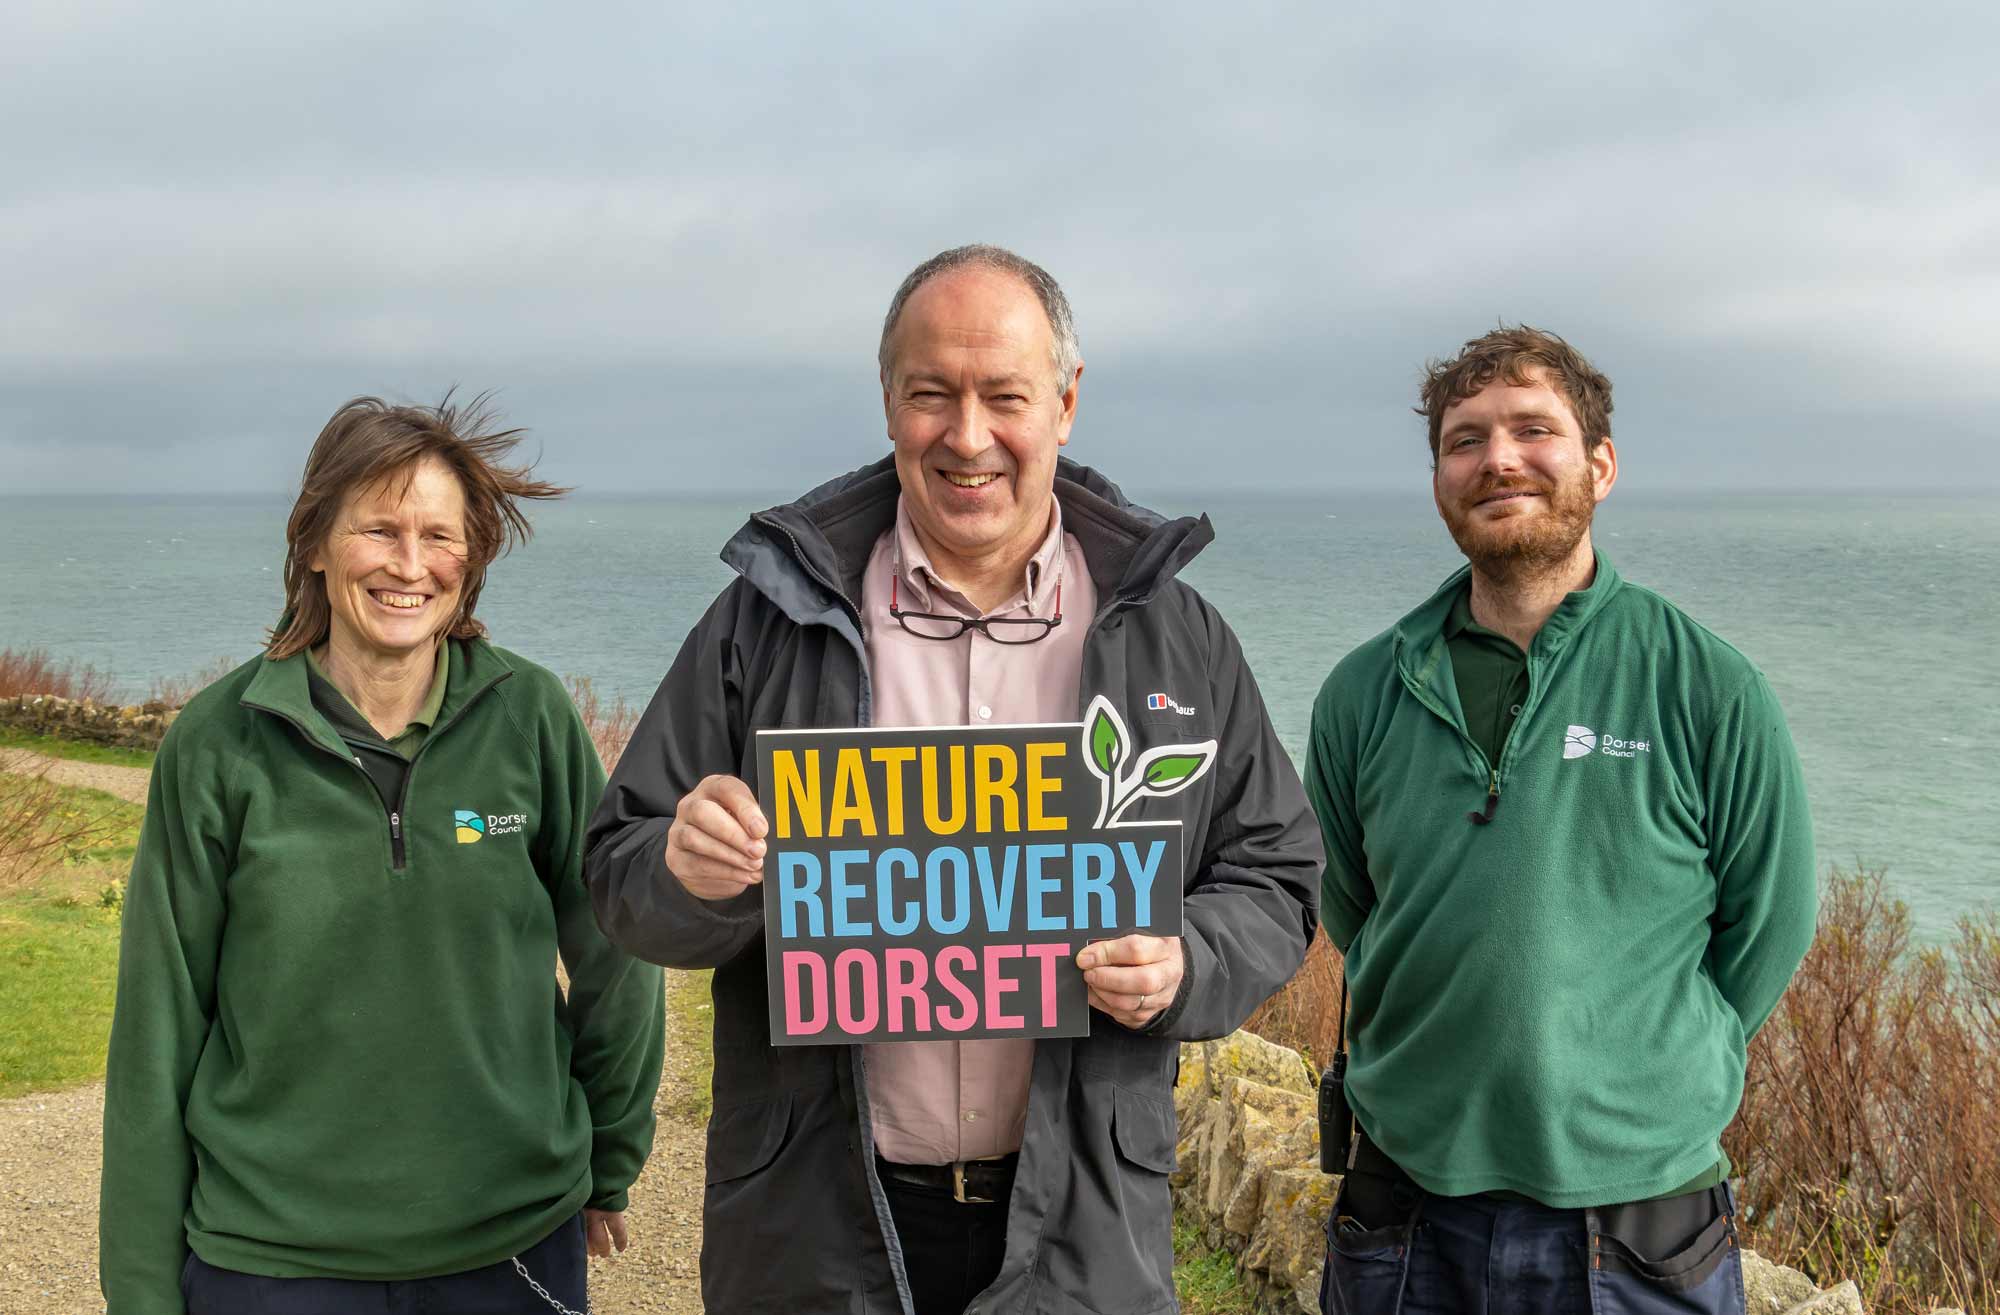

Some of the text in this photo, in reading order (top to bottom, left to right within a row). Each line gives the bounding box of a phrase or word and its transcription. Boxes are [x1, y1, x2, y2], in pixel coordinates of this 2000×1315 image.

[1602, 734, 1651, 753] Dorset
[1602, 746, 1636, 758] Council
[772, 742, 1069, 839] NATURE
[489, 824, 522, 836] Council
[777, 840, 1167, 939] RECOVERY
[782, 942, 1072, 1036] DORSET
